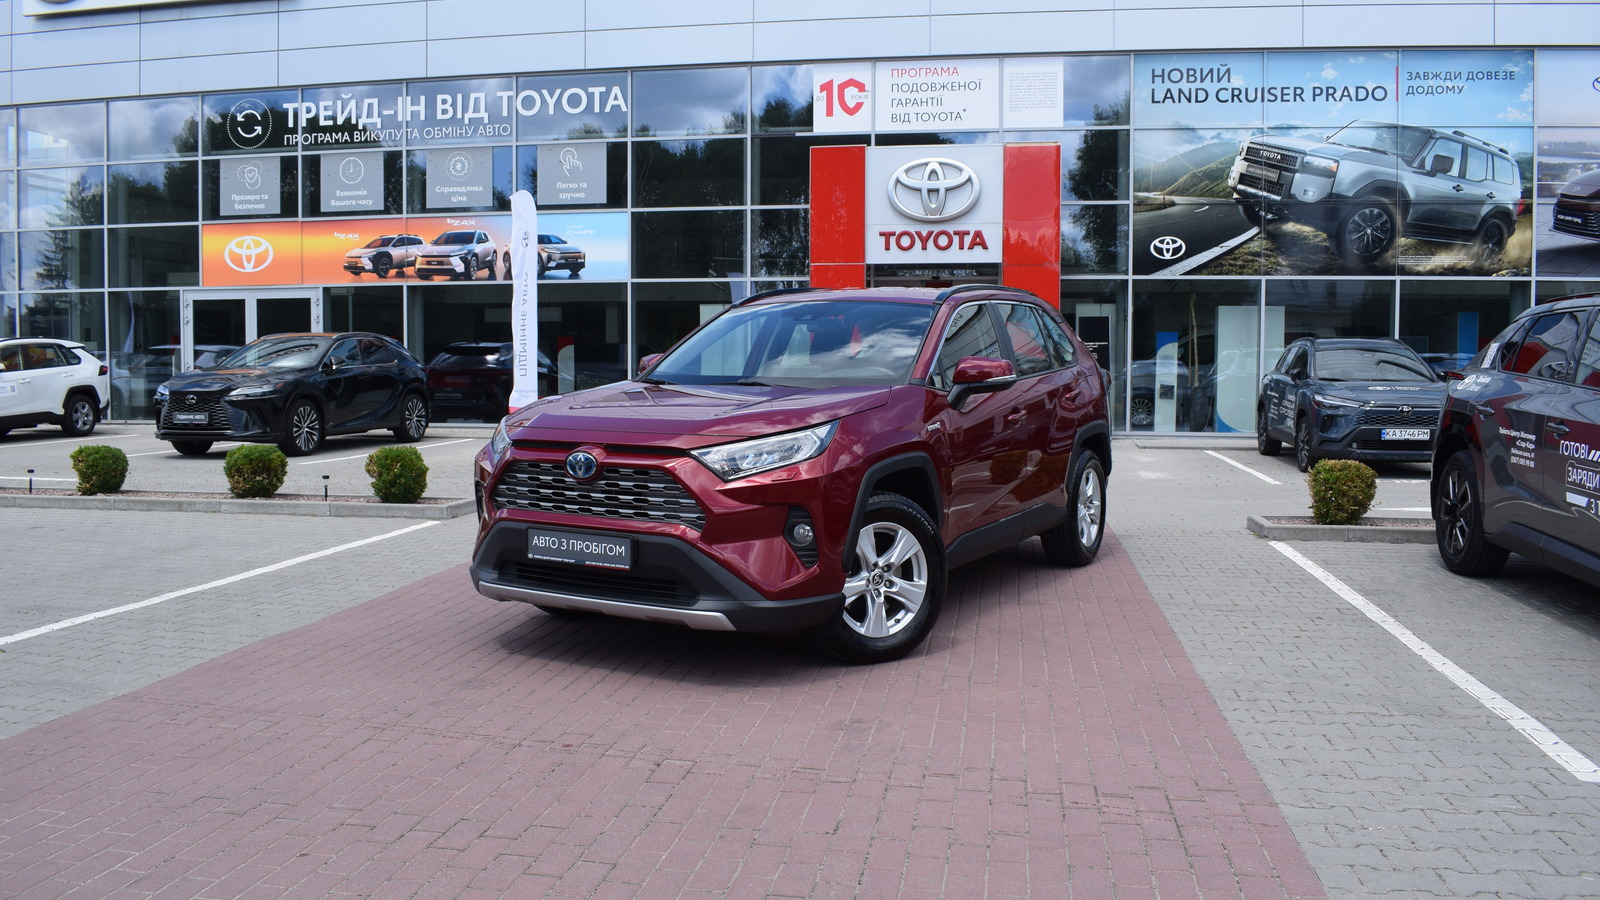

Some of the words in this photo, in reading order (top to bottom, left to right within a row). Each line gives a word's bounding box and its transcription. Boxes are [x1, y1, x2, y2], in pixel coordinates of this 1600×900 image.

[891, 66, 960, 79] ПРОГРАМА
[1151, 63, 1231, 84] НОВИЙ
[1406, 71, 1462, 82] ЗАВЖДИ
[1465, 70, 1516, 82] ДОВЕЗЕ
[891, 78, 983, 95] ПОДОВЖЕНОЇ
[1405, 85, 1465, 97] ДОДОМУ
[1151, 87, 1209, 104] LAND
[1215, 86, 1305, 104] CRUISER
[1312, 85, 1389, 103] PRADO
[891, 94, 944, 108] ГАРАНТІЇ
[282, 92, 426, 130] ТРЕЙД-ІН
[436, 91, 489, 125] ВІД
[496, 85, 628, 117] TOYOTA
[891, 112, 911, 125] ВІД
[284, 131, 351, 146] ПРОГРАМА
[353, 129, 402, 143] ВИКУПУ
[406, 128, 420, 139] ТА
[423, 125, 475, 139] ОБМІНУ
[477, 123, 511, 136] АВТО
[1260, 150, 1281, 160] TOYOTA
[435, 184, 484, 194] Справедлива
[556, 181, 578, 190] Легко
[231, 193, 260, 202] Прозоро
[336, 189, 367, 197] Економія
[451, 194, 467, 202] ціна
[558, 191, 586, 200] зручно
[234, 202, 266, 210] безпечно
[357, 198, 373, 206] часу
[879, 229, 989, 251] TOYOTA
[1385, 429, 1397, 438] KA
[1399, 429, 1416, 438] 3746
[1559, 440, 1589, 460] ГОТОВІ
[532, 535, 559, 549] АВТО
[560, 538, 567, 550] З
[569, 539, 625, 557] ПРОБІГОМ
